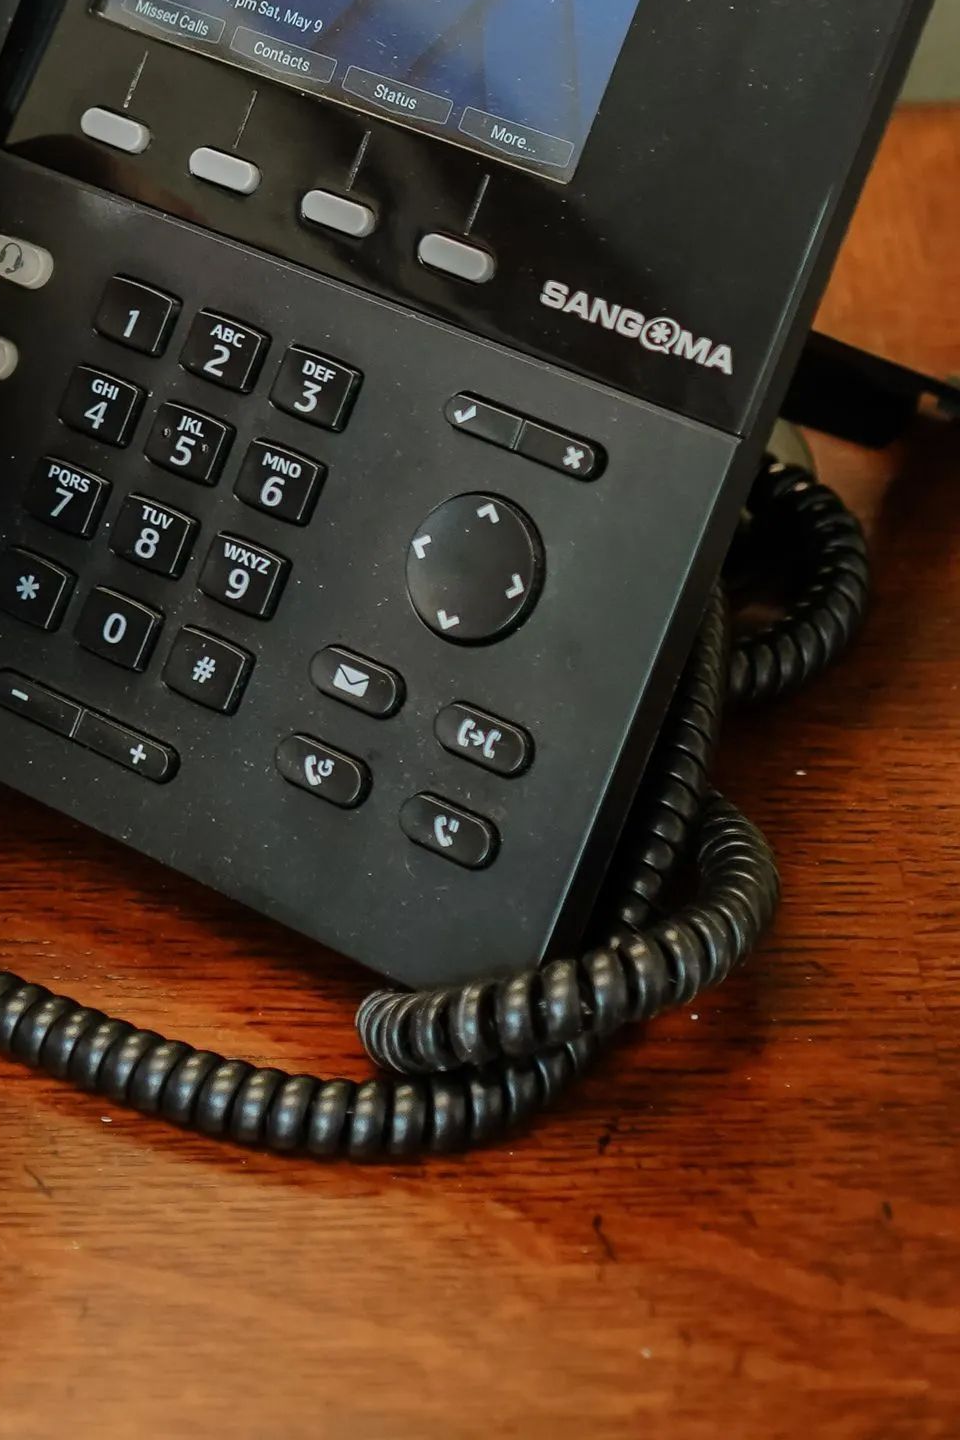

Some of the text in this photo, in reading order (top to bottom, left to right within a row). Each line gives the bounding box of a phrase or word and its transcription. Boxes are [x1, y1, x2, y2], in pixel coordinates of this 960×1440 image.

[179, 12, 209, 36] Calls
[284, 8, 311, 33] May
[313, 18, 323, 34] 9
[253, 41, 310, 72] Contacts
[374, 83, 417, 110] Status
[490, 124, 536, 153] More...
[124, 309, 141, 338] 1
[210, 324, 246, 349] ABC
[204, 344, 230, 377] 2
[302, 359, 335, 384] DEF
[91, 377, 120, 401] GHI
[293, 381, 321, 413] 3
[83, 401, 105, 430] 4
[176, 414, 206, 438] JKL
[169, 437, 194, 467] 5
[261, 452, 303, 480] MNO
[48, 464, 91, 494] PQRS
[260, 476, 284, 507] 6
[49, 488, 74, 519] 7
[141, 504, 175, 530] TUV
[134, 528, 160, 560] 8
[223, 541, 271, 574] WXYZ
[224, 568, 250, 601] 9
[102, 613, 128, 644] 0
